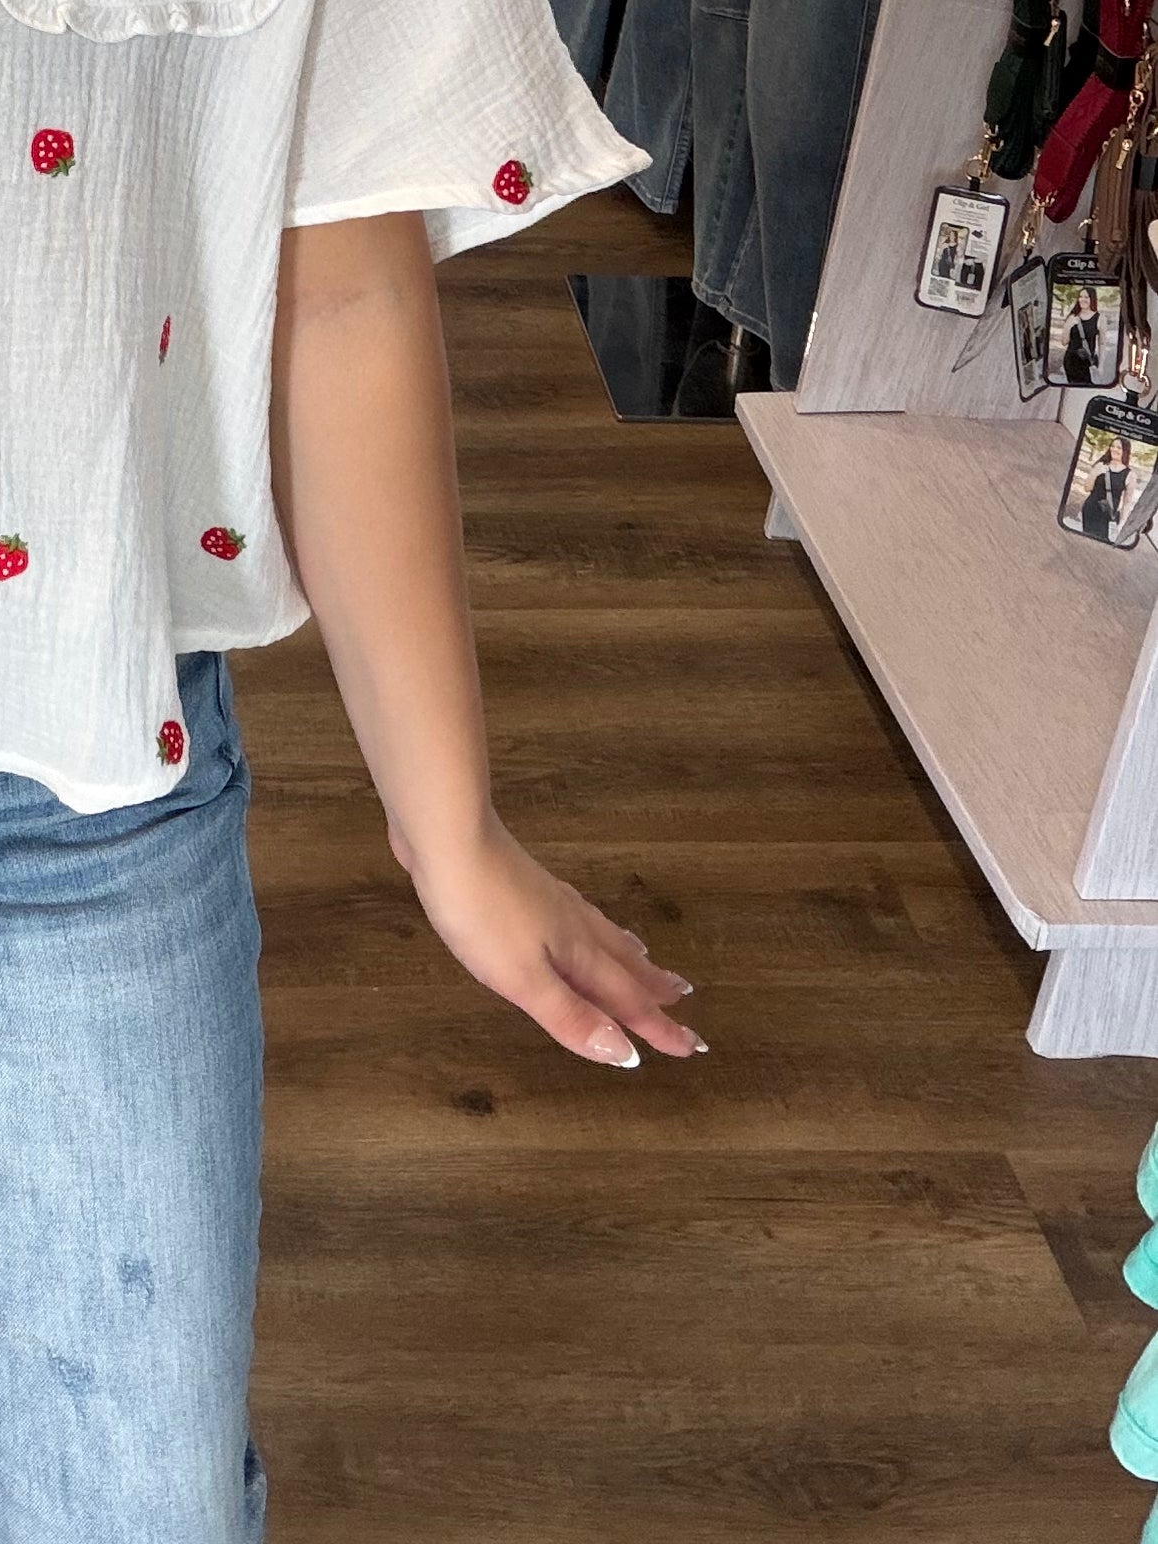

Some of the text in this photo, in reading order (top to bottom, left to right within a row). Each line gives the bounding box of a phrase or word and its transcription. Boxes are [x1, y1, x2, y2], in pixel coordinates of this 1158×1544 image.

[1067, 259, 1096, 270] Clip &
[1105, 404, 1152, 425] Clip & Go
